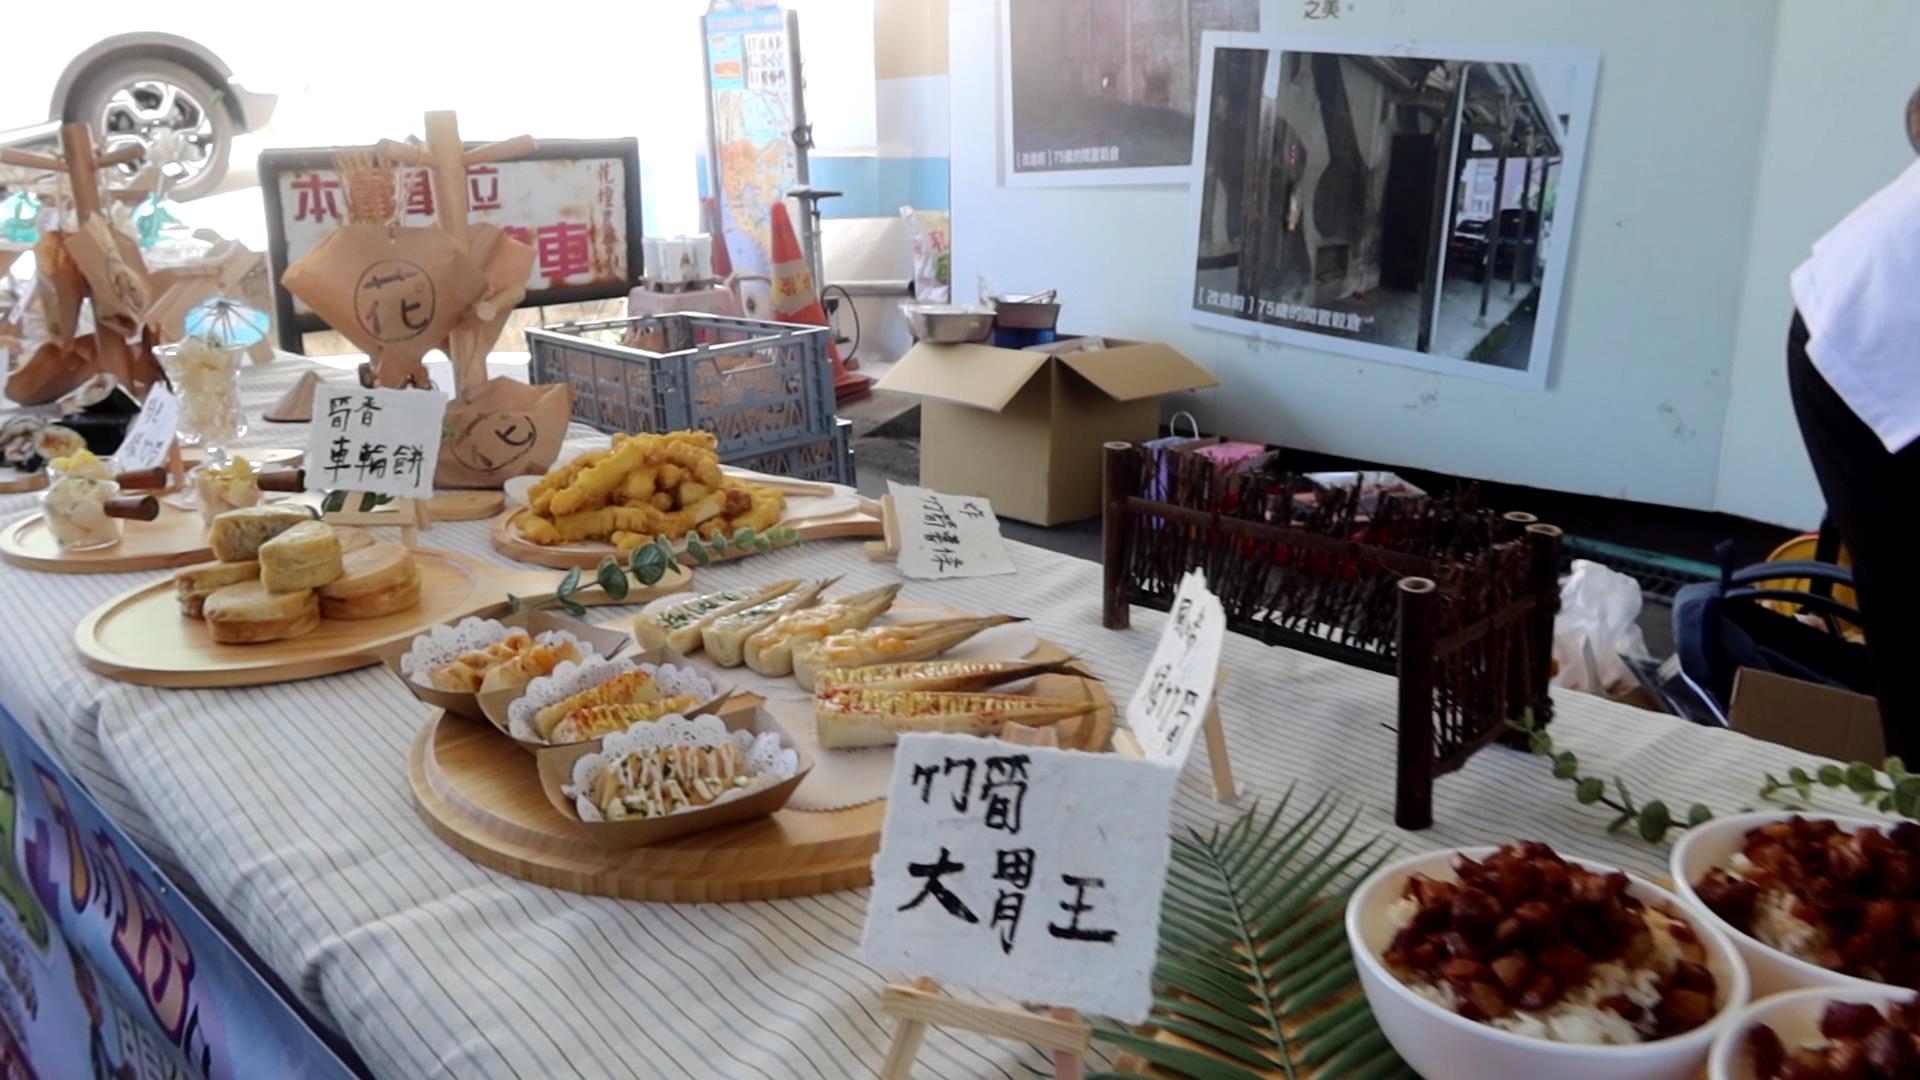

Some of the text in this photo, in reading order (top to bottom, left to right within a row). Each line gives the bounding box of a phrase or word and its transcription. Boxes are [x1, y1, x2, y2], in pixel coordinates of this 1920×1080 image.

[362, 269, 430, 336] 花
[328, 396, 382, 432] 筍香
[324, 435, 424, 488] 車輪餅
[911, 753, 1032, 835] 竹筍
[897, 846, 1119, 955] 大胃王
